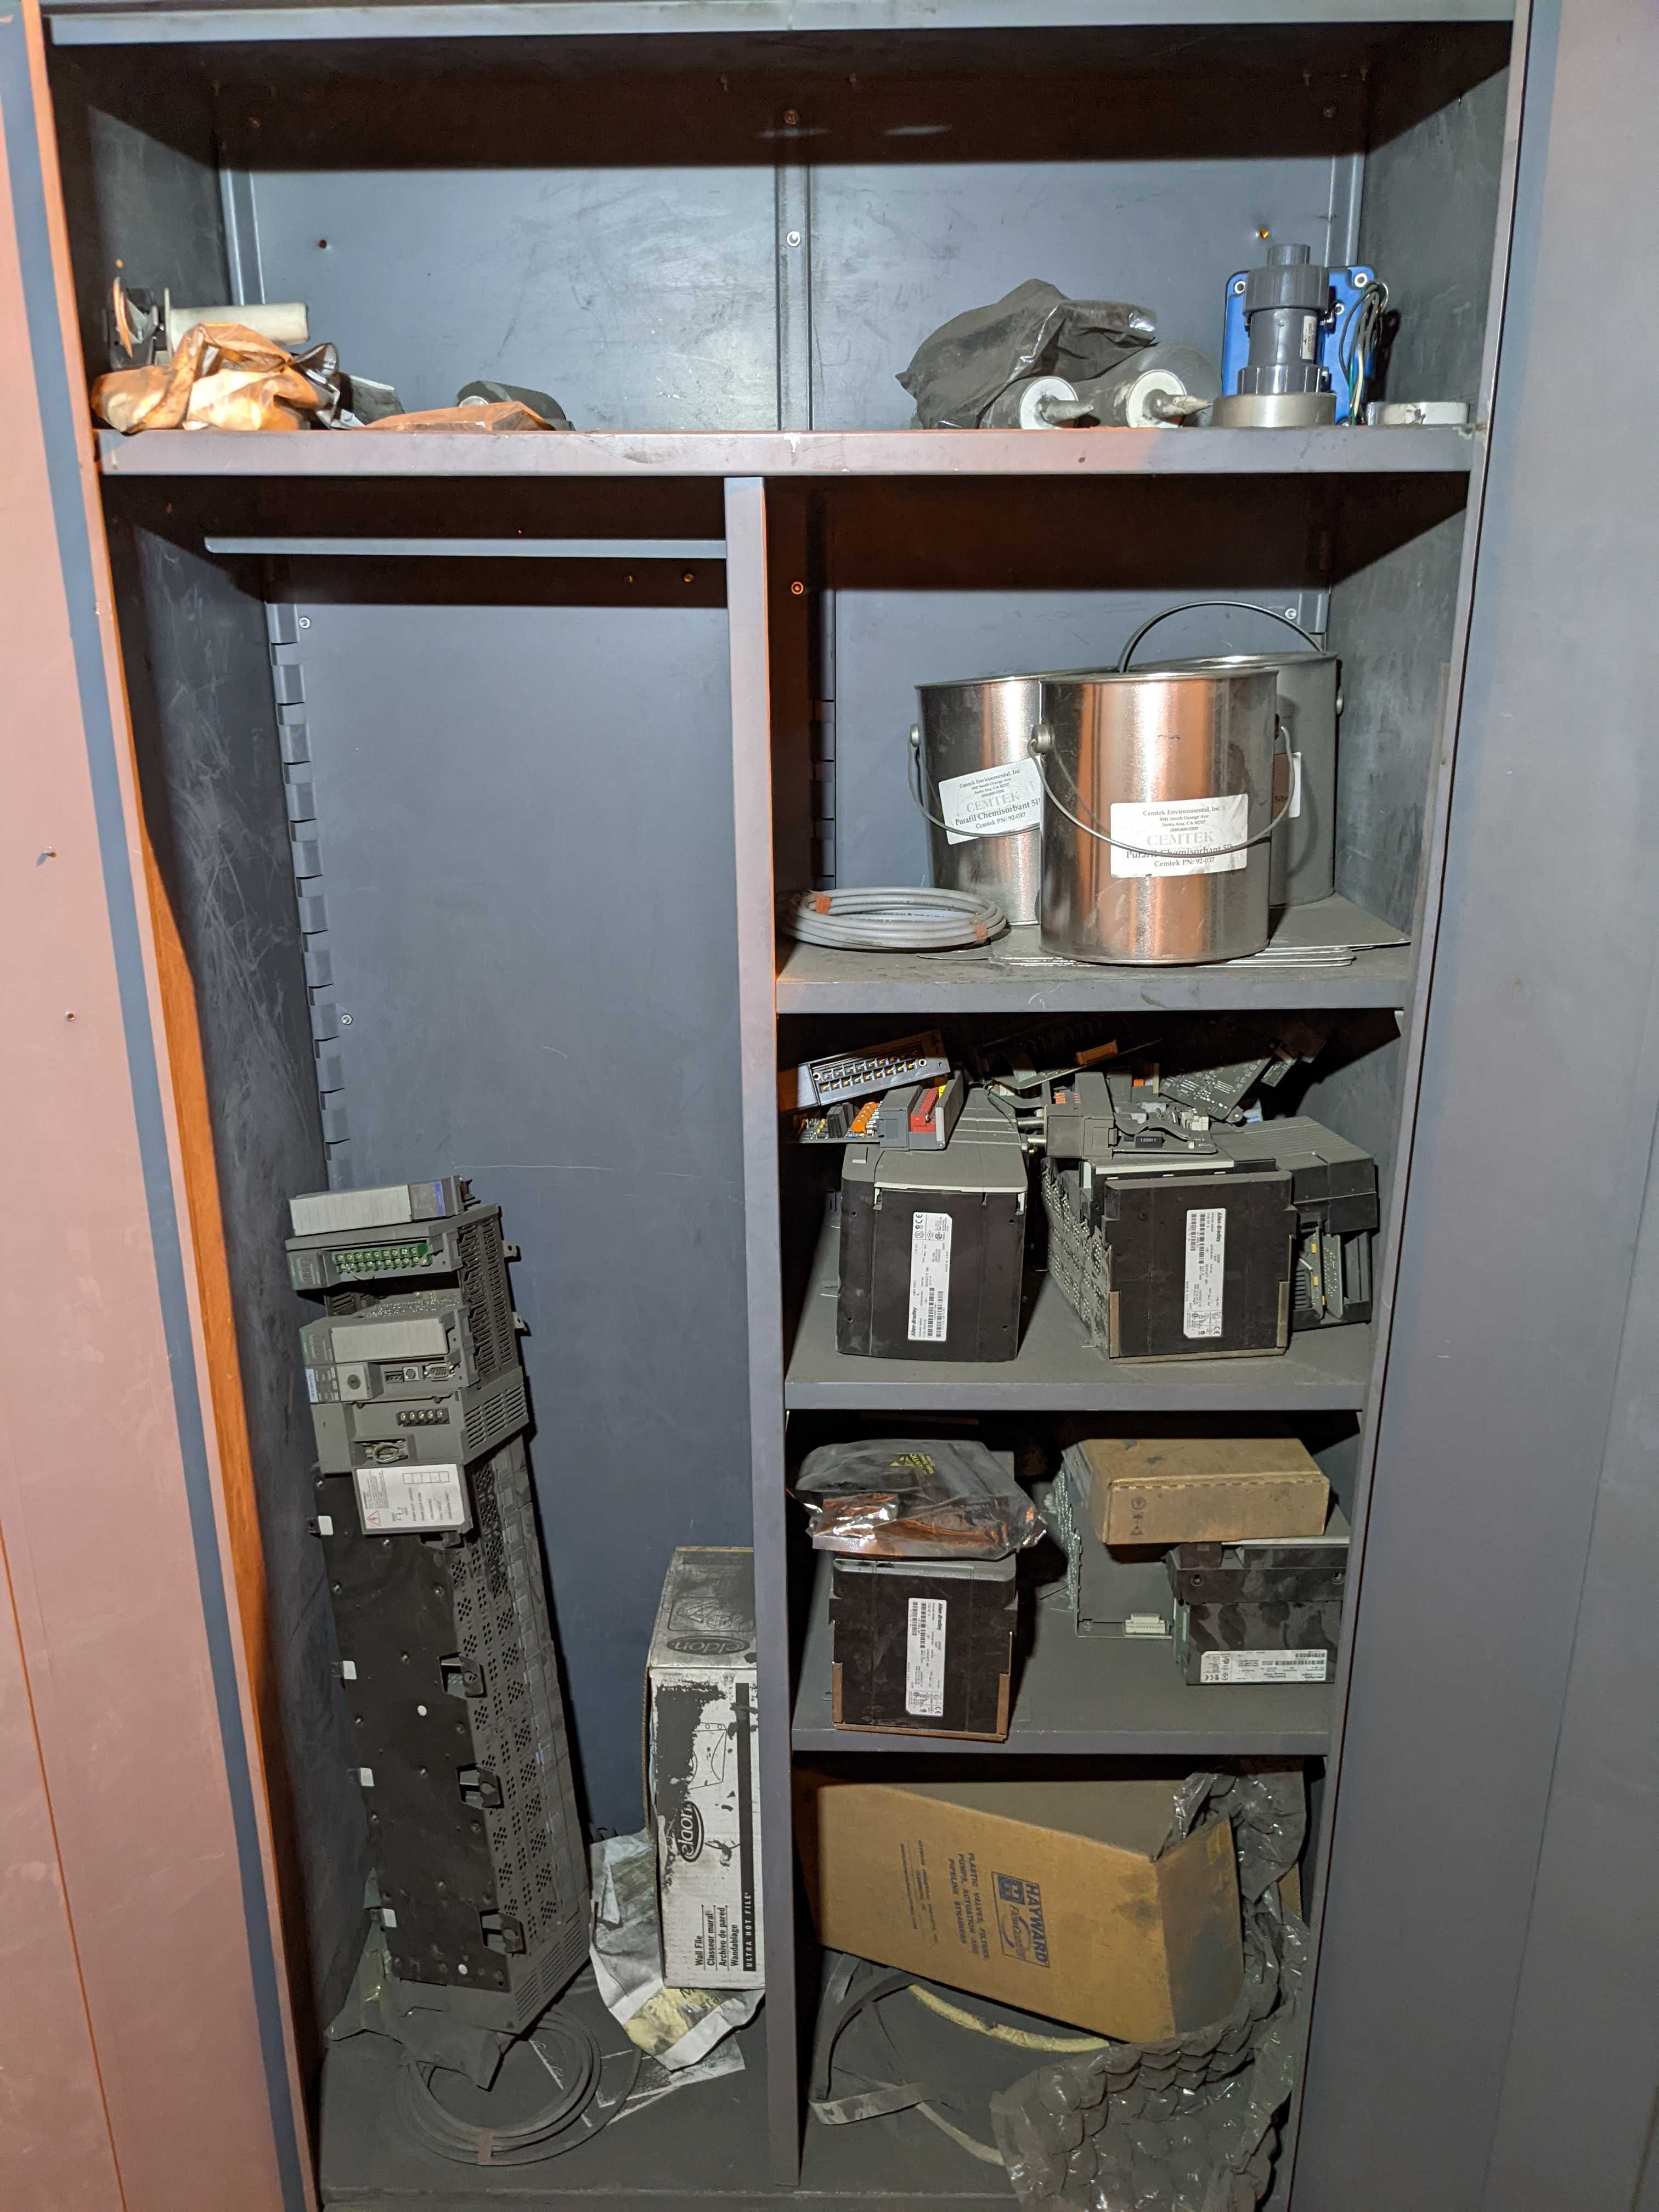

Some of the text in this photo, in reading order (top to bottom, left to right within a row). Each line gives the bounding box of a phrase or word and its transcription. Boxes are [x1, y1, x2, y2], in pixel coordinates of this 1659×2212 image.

[976, 772, 1012, 785] Environmental,
[955, 815, 977, 826] Purafil
[978, 803, 1030, 820] Chemisorbant
[966, 791, 1022, 812] CEMTEK
[1167, 807, 1211, 815] Environmental,
[975, 820, 996, 829] Cemtek
[1008, 812, 1026, 822] 92-037
[1147, 831, 1214, 846] CEMTEK
[674, 1641, 744, 1654] eldon
[968, 1852, 978, 1888] PLASTIC
[963, 1888, 975, 1934] ACTUATION
[1025, 1883, 1048, 1963] HAYWARD
[694, 1935, 703, 1966] Wall File
[705, 1913, 715, 1966] Classeur mural
[717, 1908, 727, 1966] Archivo de pared
[730, 1925, 739, 1966] Wandablage
